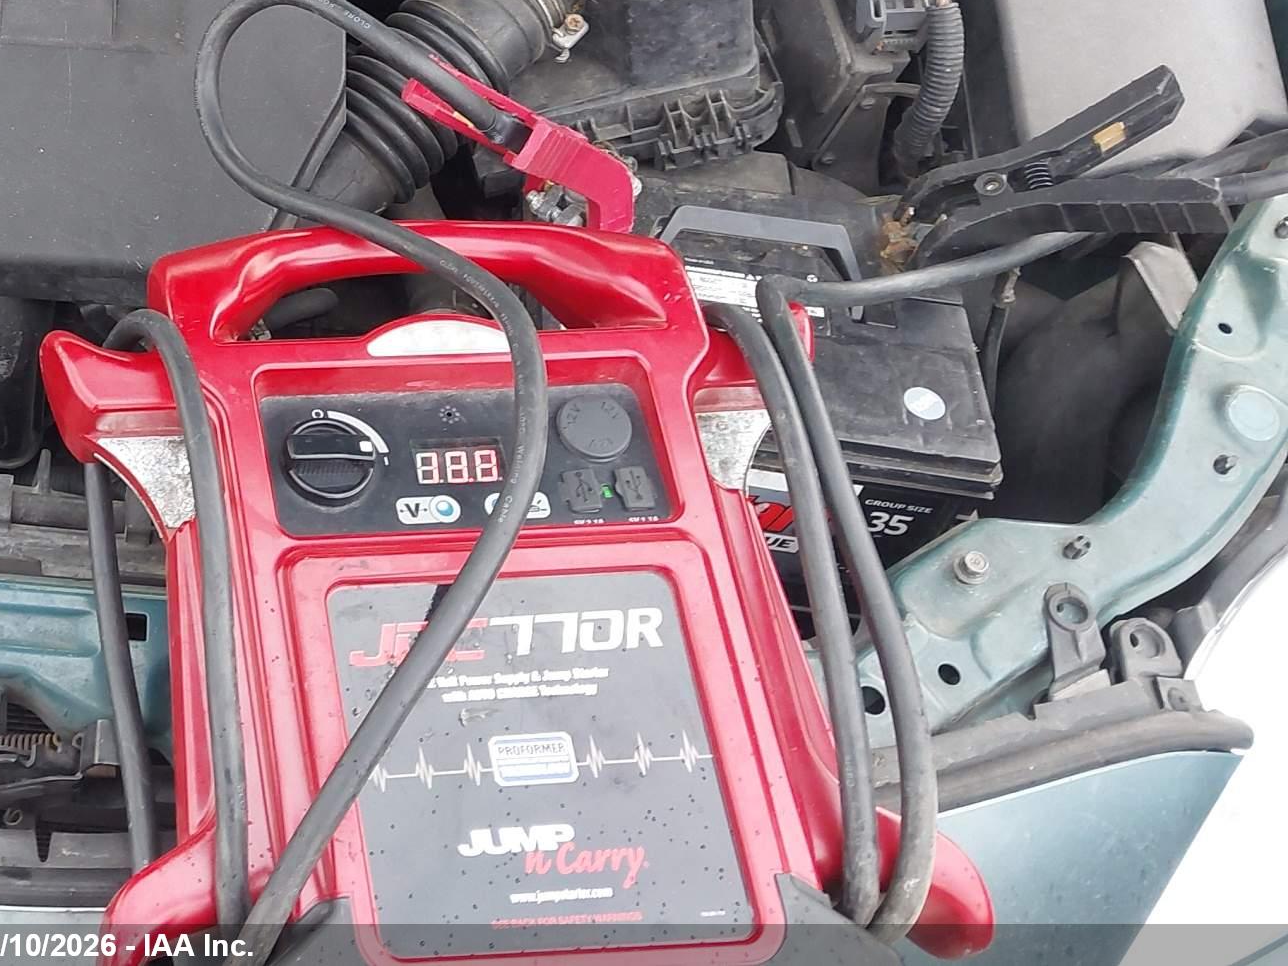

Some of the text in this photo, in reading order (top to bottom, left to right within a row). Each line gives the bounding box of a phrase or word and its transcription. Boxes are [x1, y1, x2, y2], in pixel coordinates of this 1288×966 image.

[864, 498, 934, 515] GROUP SIZE
[867, 510, 915, 536] 35
[497, 742, 567, 757] PROFORMER
[457, 823, 576, 857] JUMP
[555, 840, 647, 889] Carry
